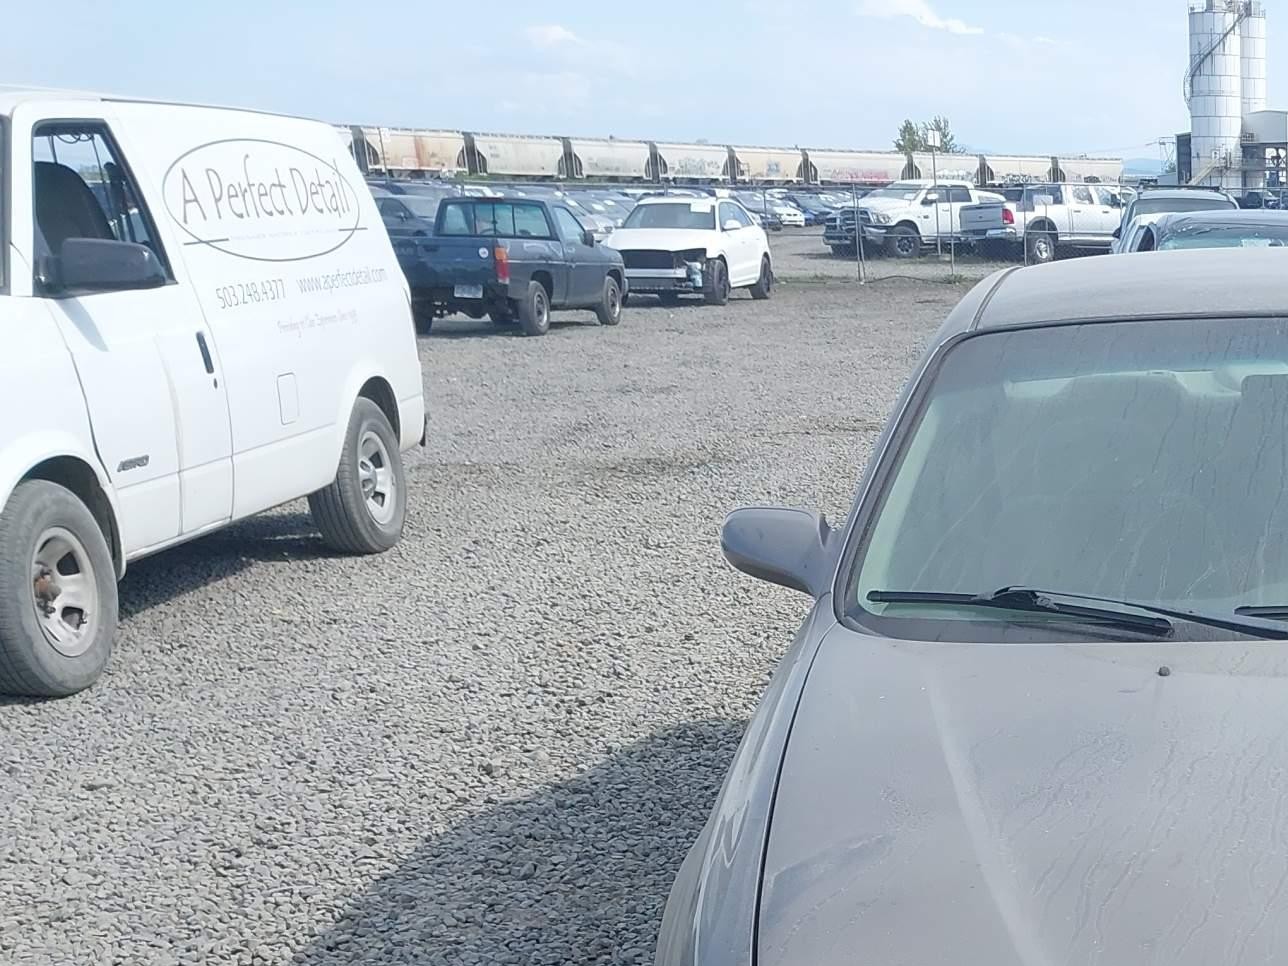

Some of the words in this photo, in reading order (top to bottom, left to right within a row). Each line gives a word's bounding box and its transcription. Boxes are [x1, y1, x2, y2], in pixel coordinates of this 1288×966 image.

[180, 167, 207, 225] A
[205, 153, 294, 221] Perfect
[288, 158, 351, 219] Detail
[216, 278, 287, 309] 503.248.4377
